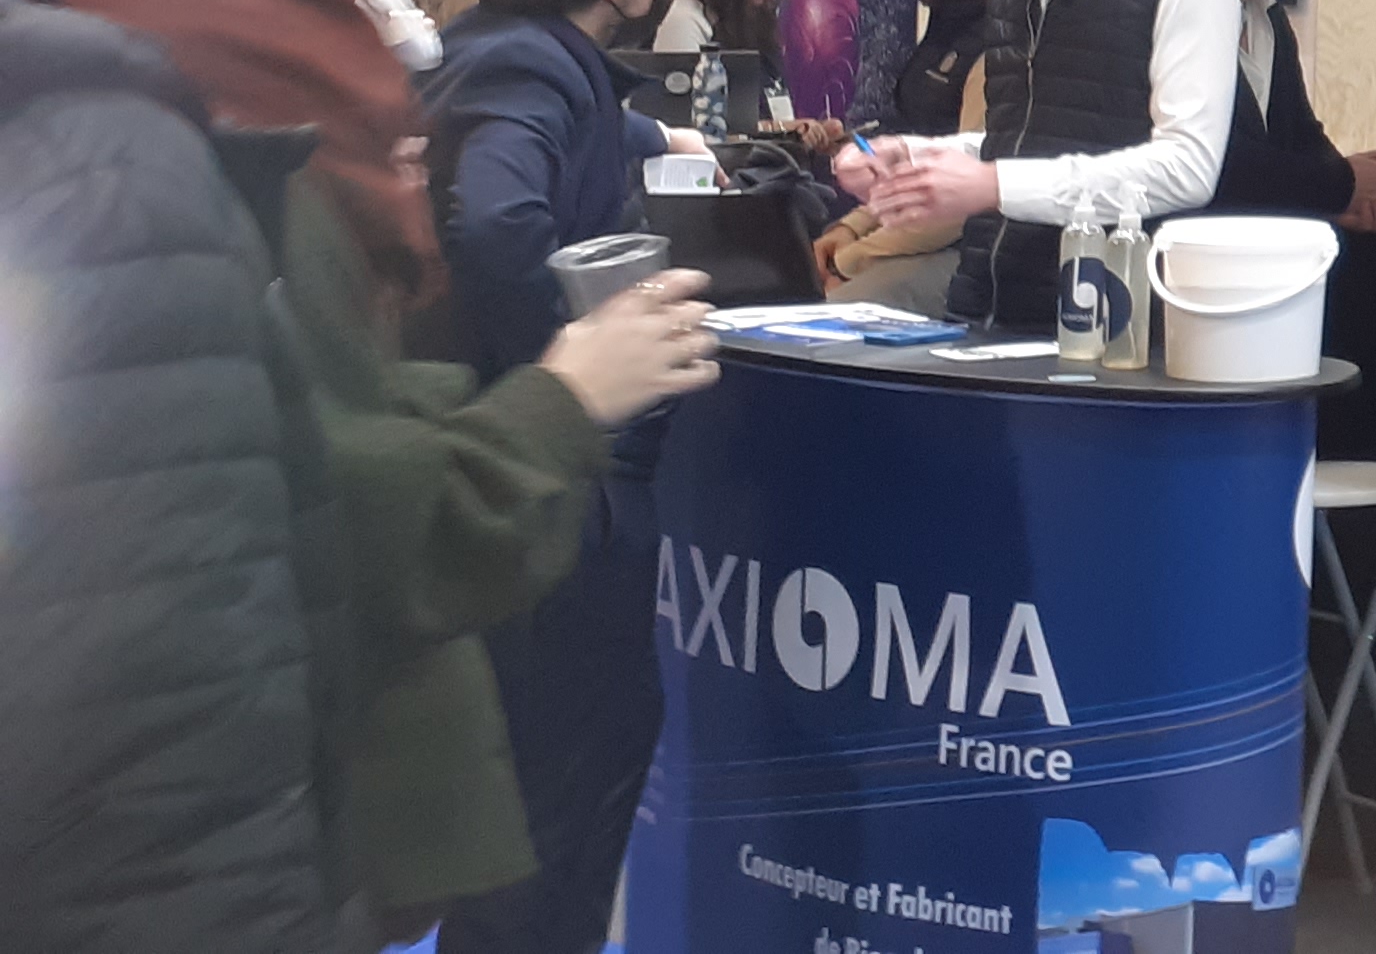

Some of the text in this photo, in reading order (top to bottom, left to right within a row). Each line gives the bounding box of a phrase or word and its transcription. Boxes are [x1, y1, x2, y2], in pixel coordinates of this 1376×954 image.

[656, 533, 1071, 727] AXIOMA
[937, 724, 1072, 782] France
[738, 843, 1012, 934] Concepteur et Fabricant
